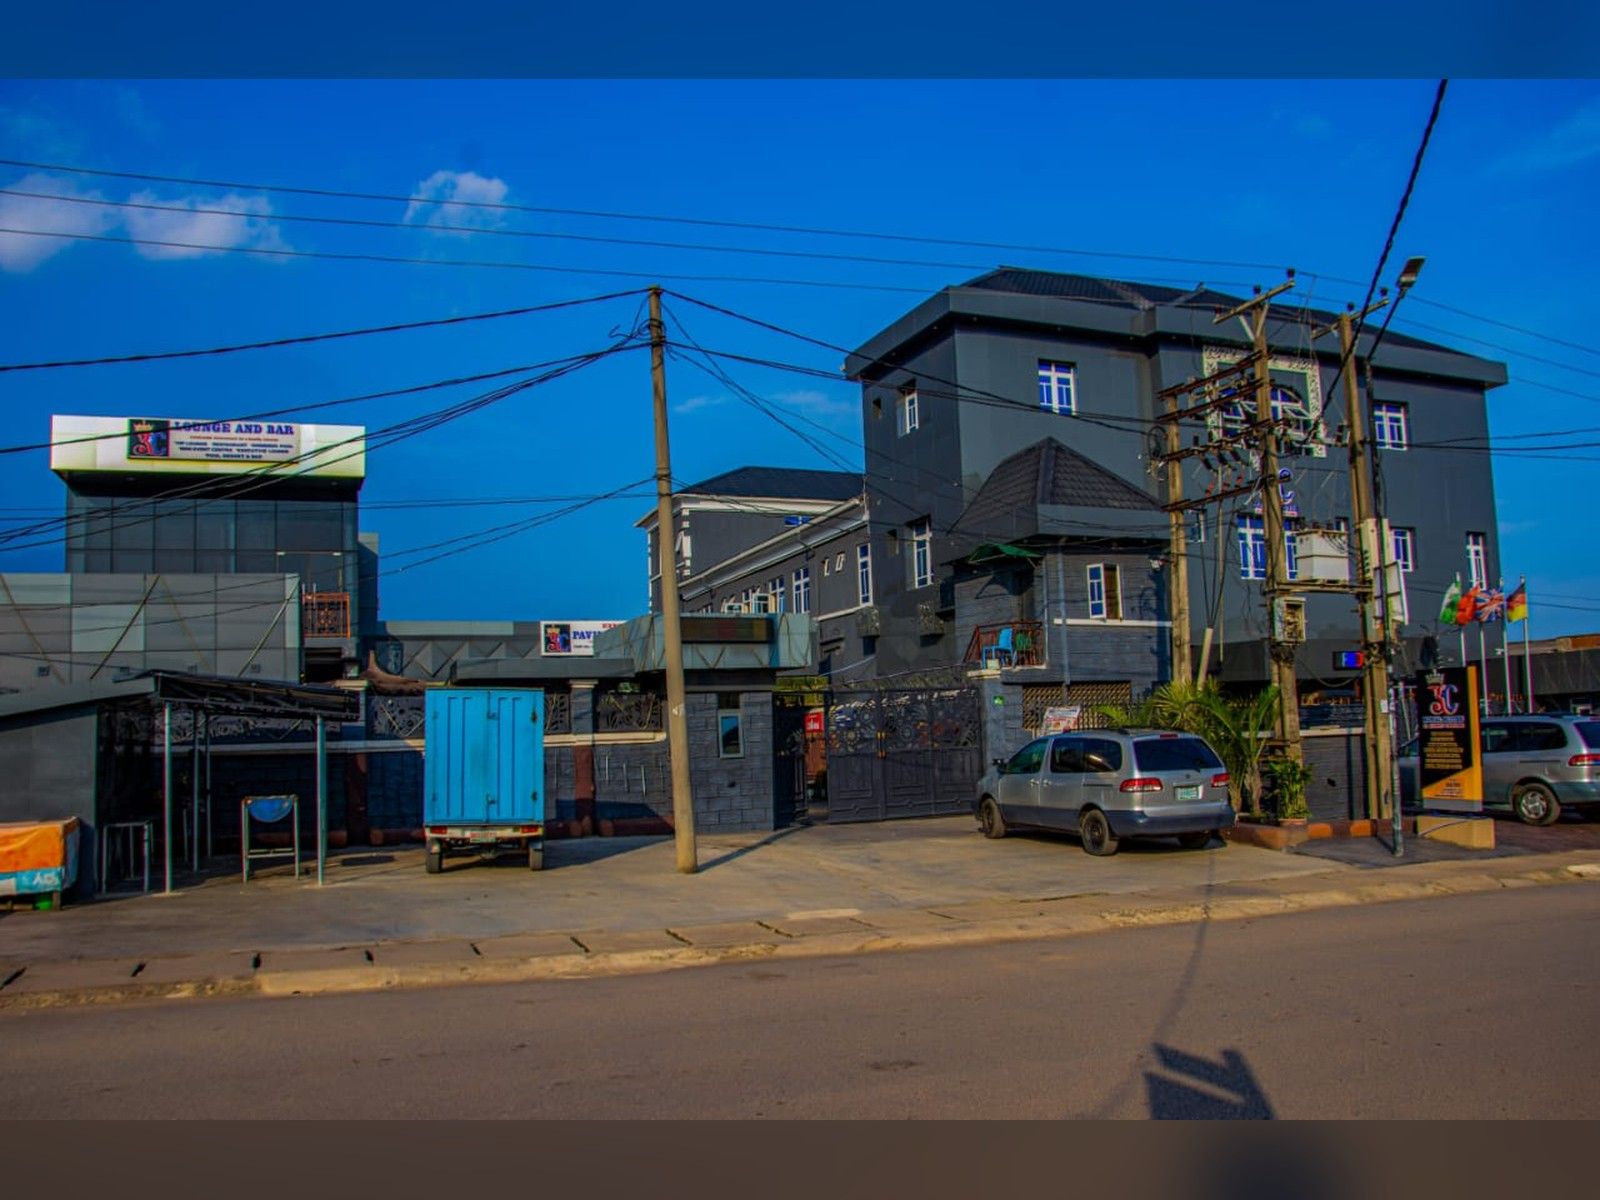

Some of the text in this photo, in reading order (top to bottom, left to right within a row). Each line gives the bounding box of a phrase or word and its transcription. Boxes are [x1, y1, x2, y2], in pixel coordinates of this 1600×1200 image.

[174, 421, 294, 435] LOUNGE AND BAR
